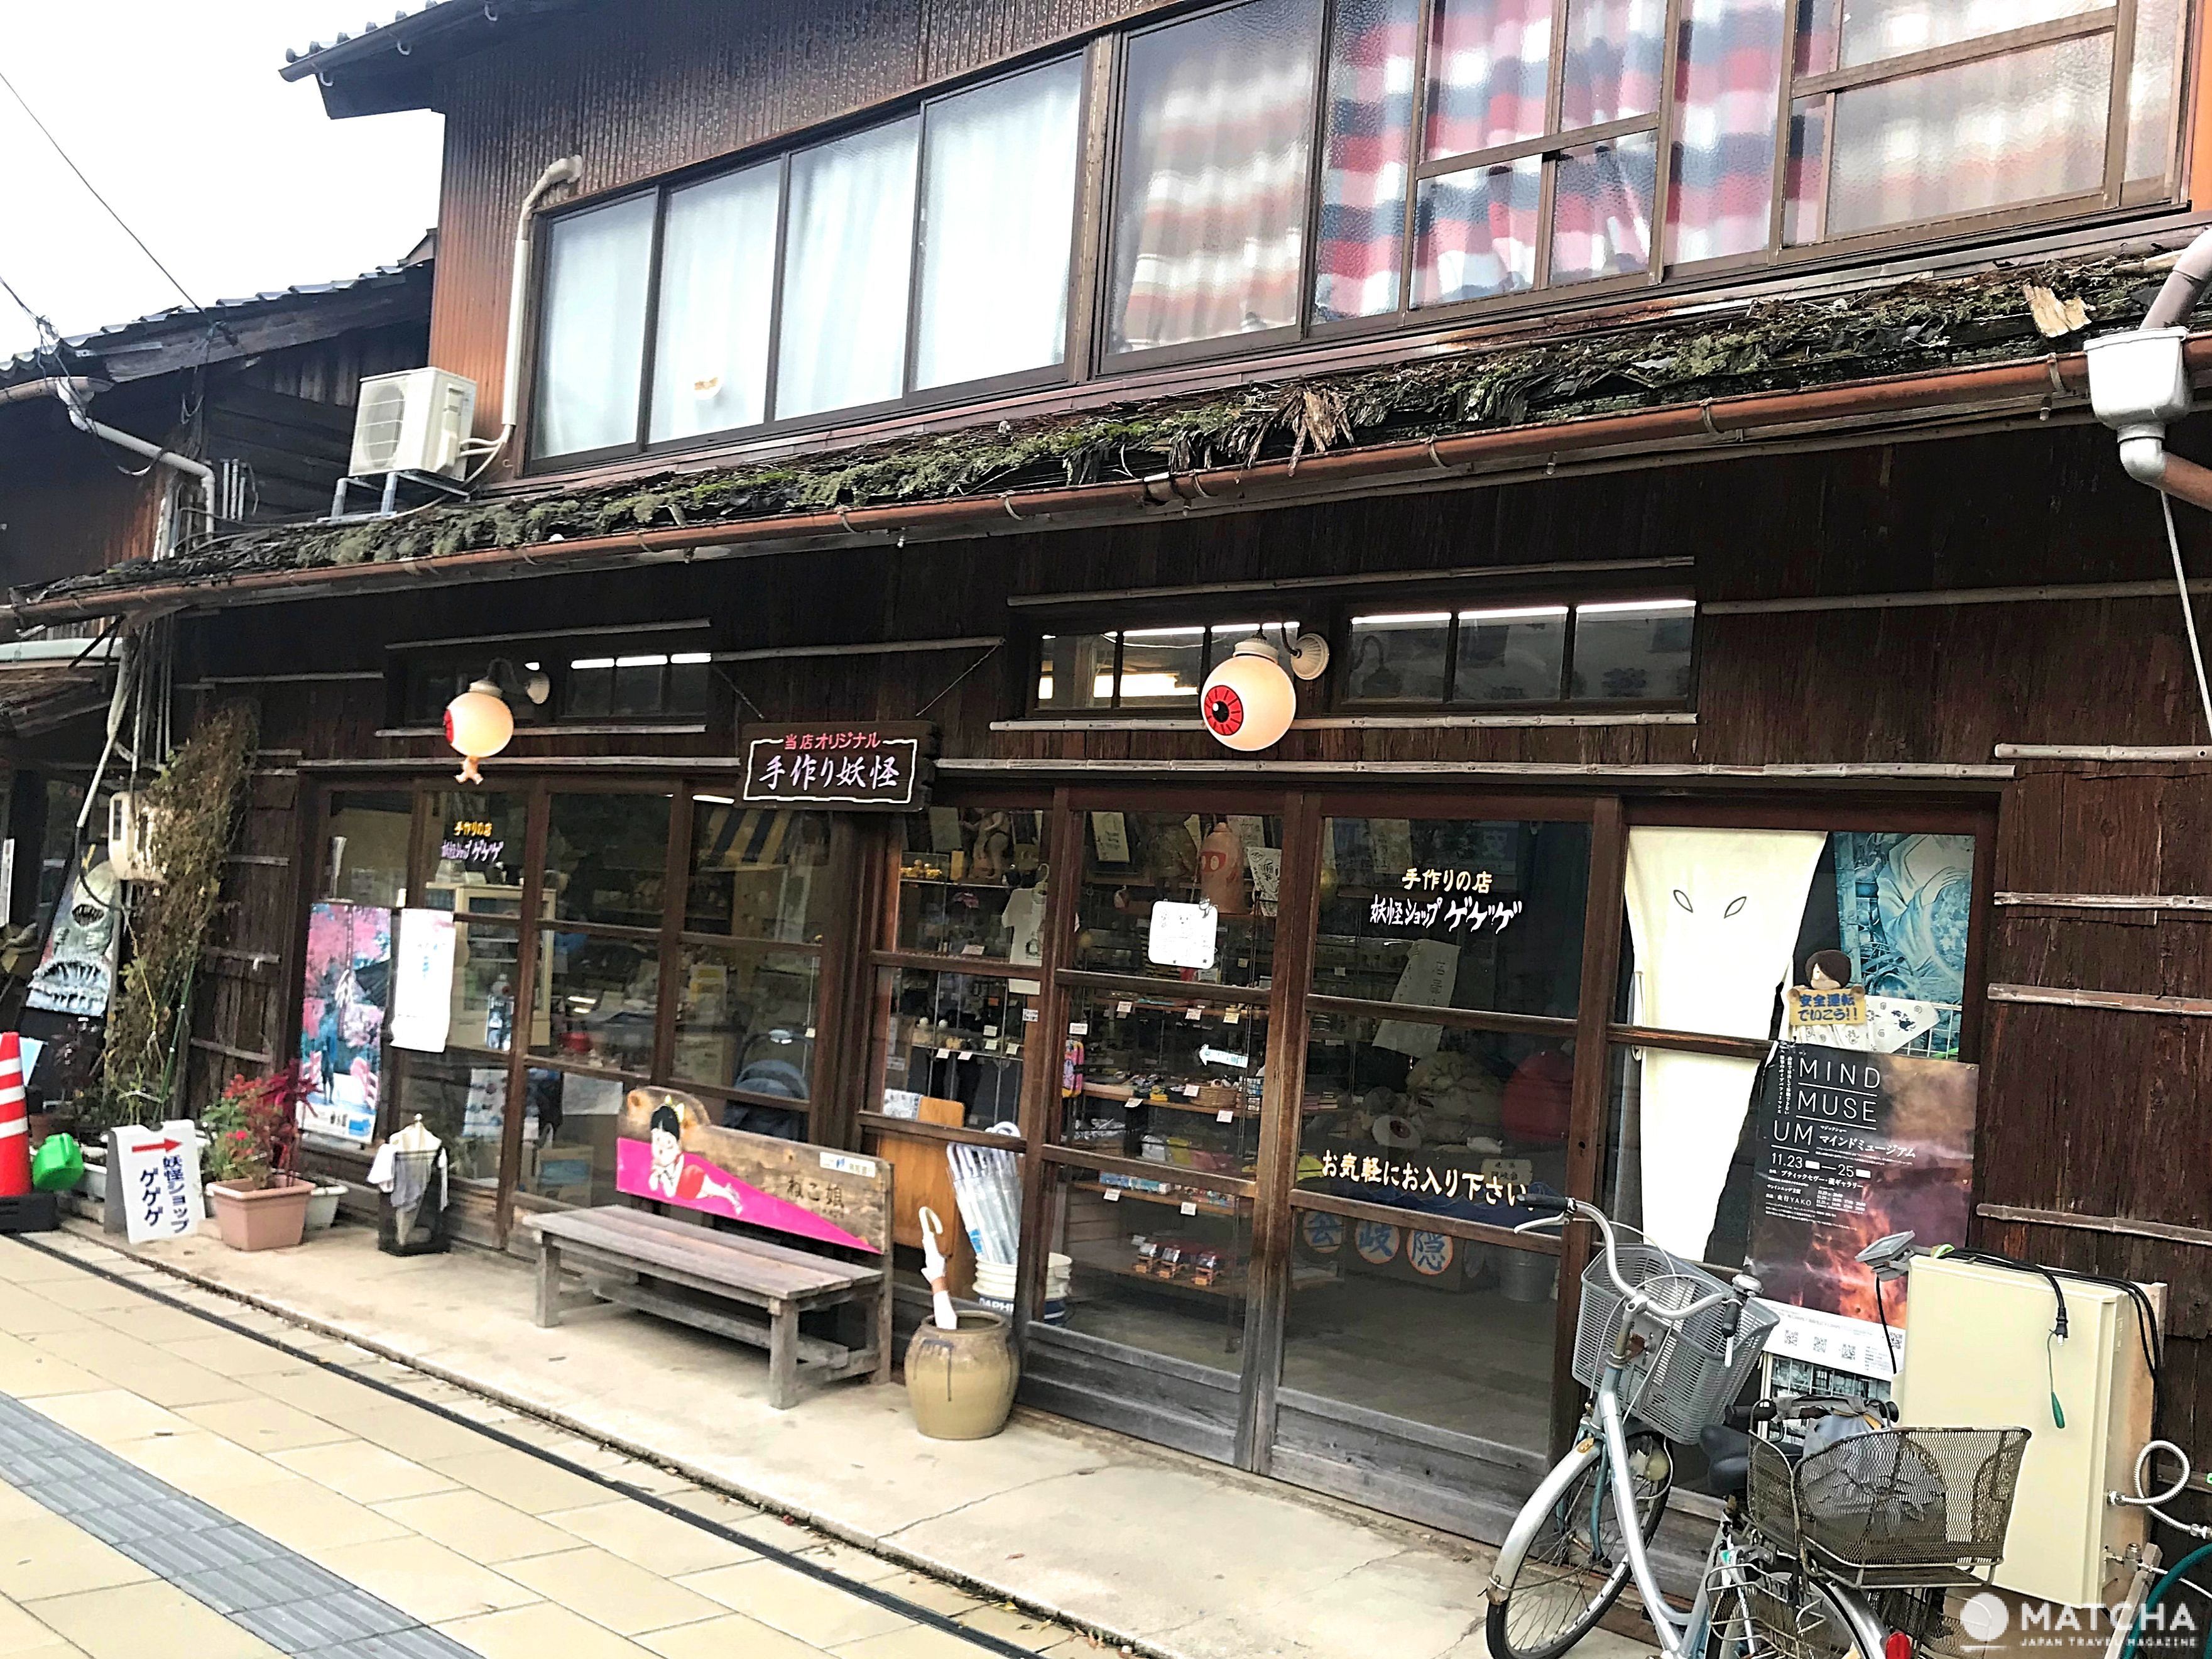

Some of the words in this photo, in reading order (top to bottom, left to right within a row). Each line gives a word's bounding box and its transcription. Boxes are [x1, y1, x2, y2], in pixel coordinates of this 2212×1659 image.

[784, 731, 881, 750] 当店オリジナル
[758, 753, 900, 791] 手作り妖怪
[1402, 867, 1493, 894] 手作りの店
[1369, 894, 1443, 929] 妖怪ショップ
[1444, 895, 1523, 934] ゲゲゲ
[1799, 993, 1855, 1007] 安全運転
[1799, 1057, 1880, 1089] MIND
[1797, 1090, 1877, 1123] MUSE
[1773, 1119, 1814, 1146] UM
[1819, 1135, 1916, 1158] マインドミュージアム
[1772, 1152, 1803, 1169] 11.23
[1321, 1149, 1535, 1212] お気軽にお入り下さい
[139, 1166, 165, 1227] ゲゲゲ
